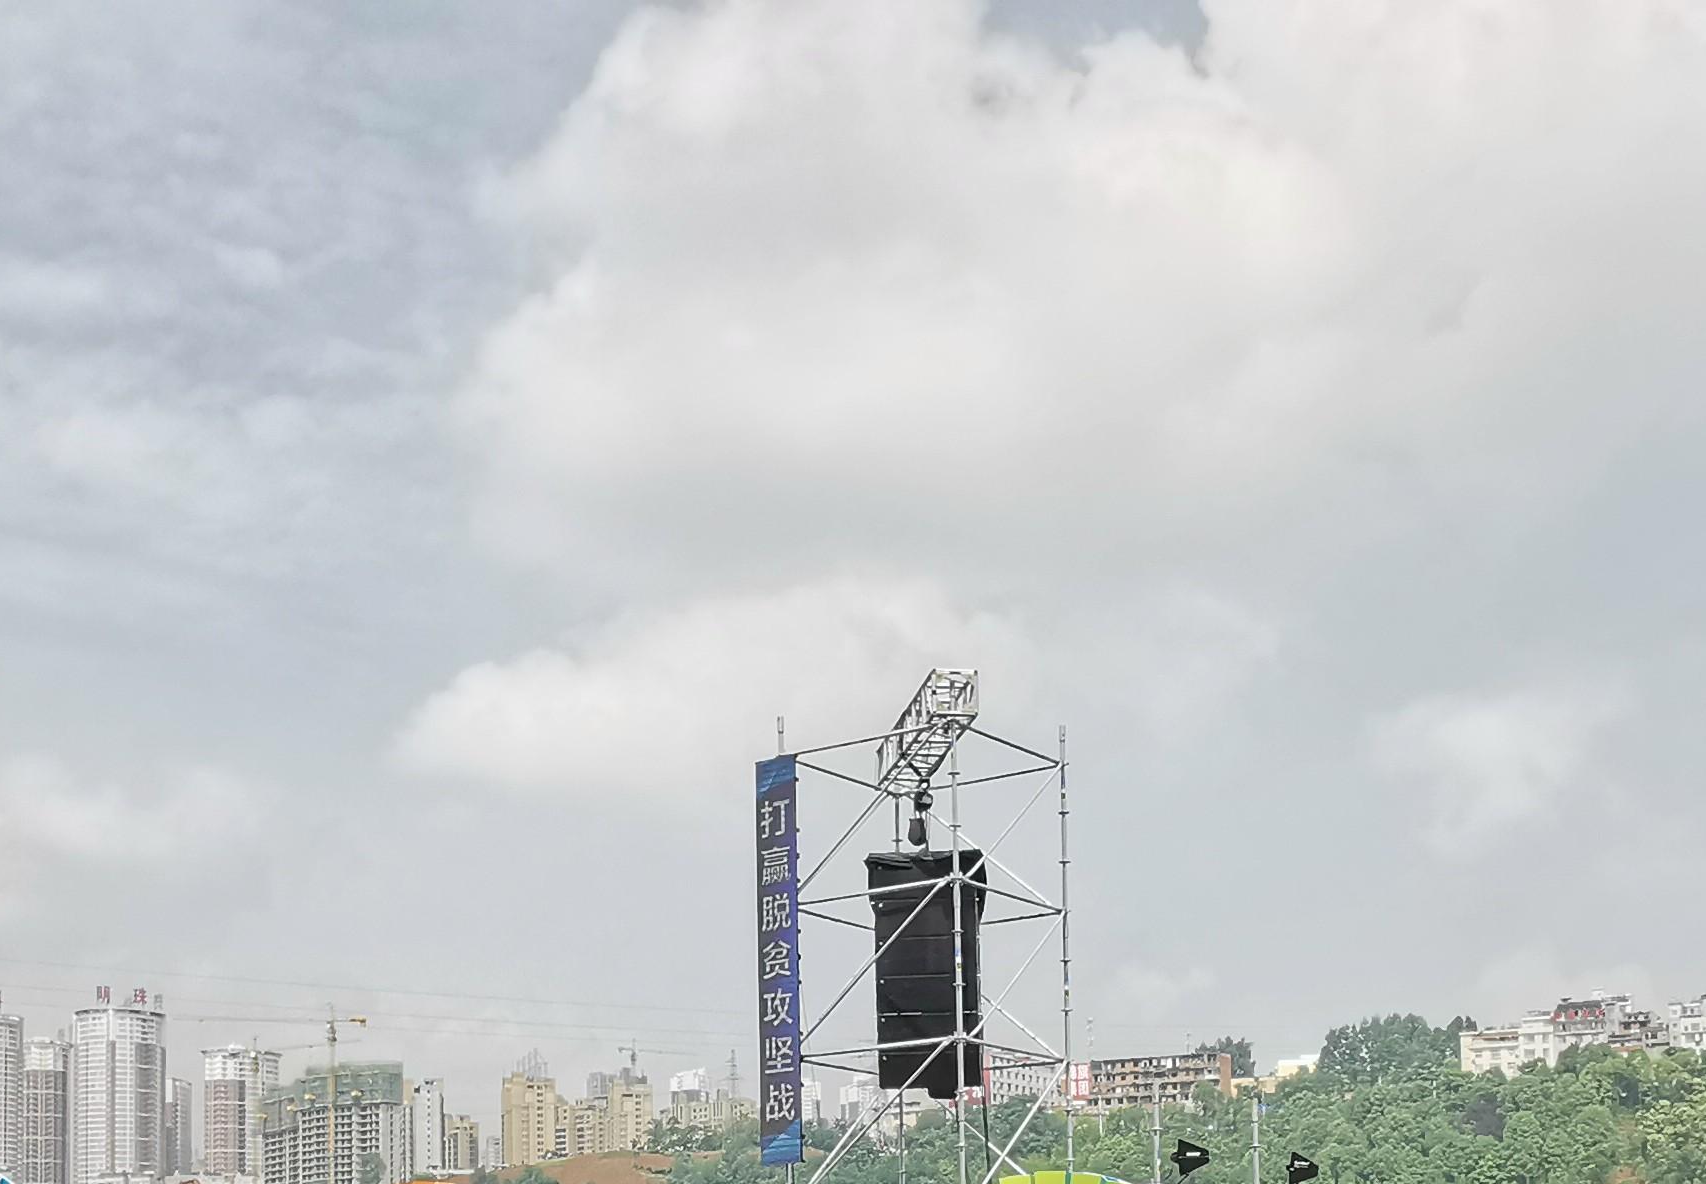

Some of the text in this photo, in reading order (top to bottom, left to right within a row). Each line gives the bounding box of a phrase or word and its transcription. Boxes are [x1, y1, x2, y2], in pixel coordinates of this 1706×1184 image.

[760, 798, 795, 1123] 打赢脱贫攻坚战
